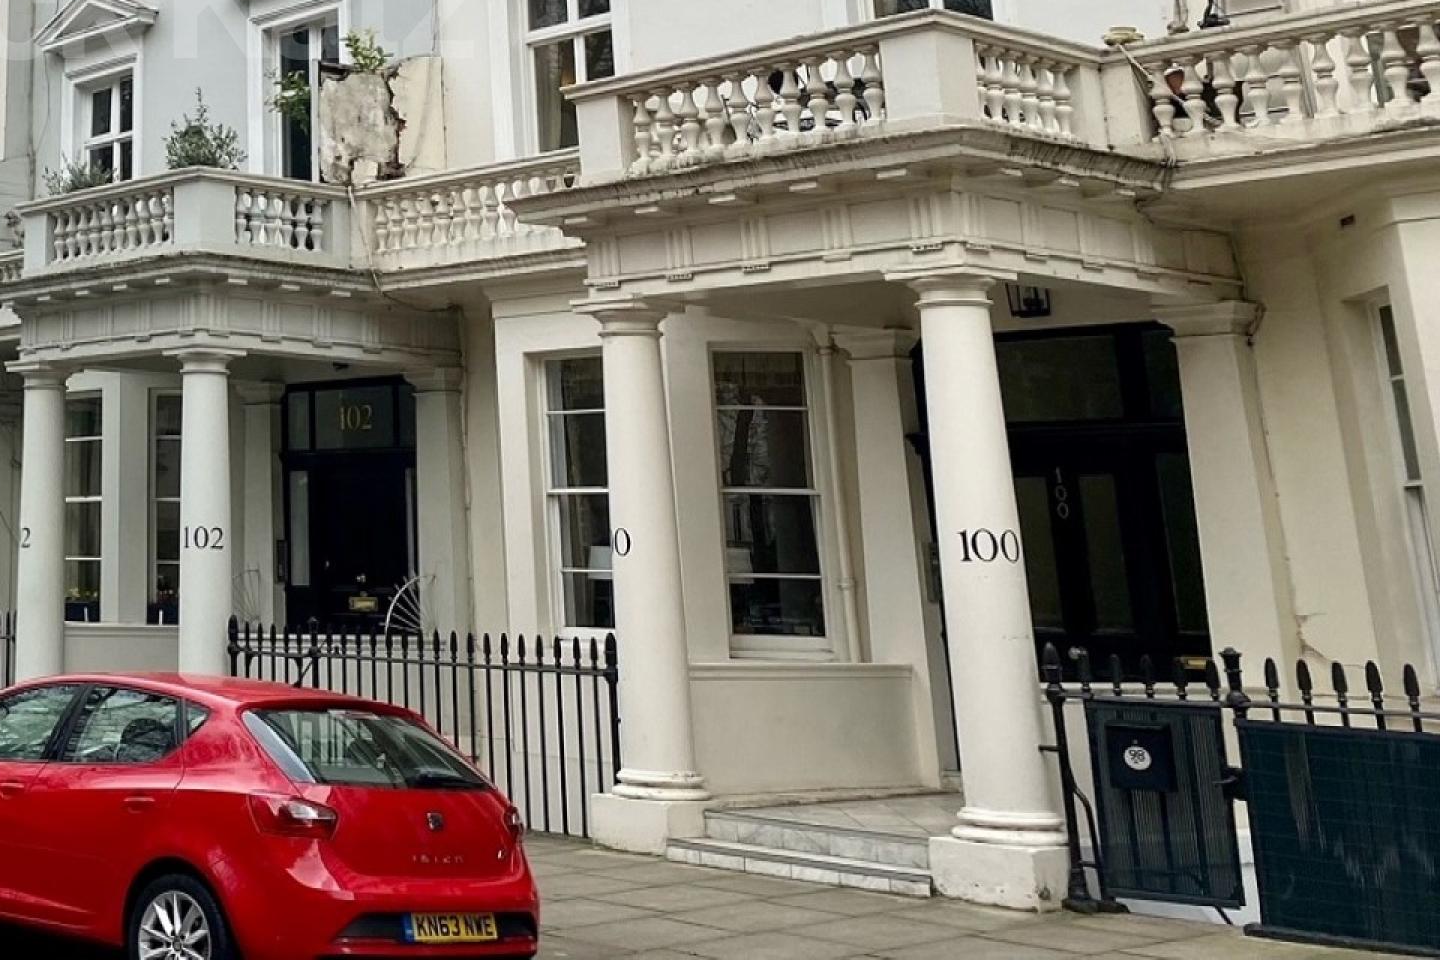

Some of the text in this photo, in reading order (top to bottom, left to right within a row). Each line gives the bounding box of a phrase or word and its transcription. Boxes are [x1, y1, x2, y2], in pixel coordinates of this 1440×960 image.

[340, 405, 372, 430] 102
[183, 526, 224, 549] 102
[956, 528, 1020, 564] 100
[415, 915, 494, 937] KN63 NWE
